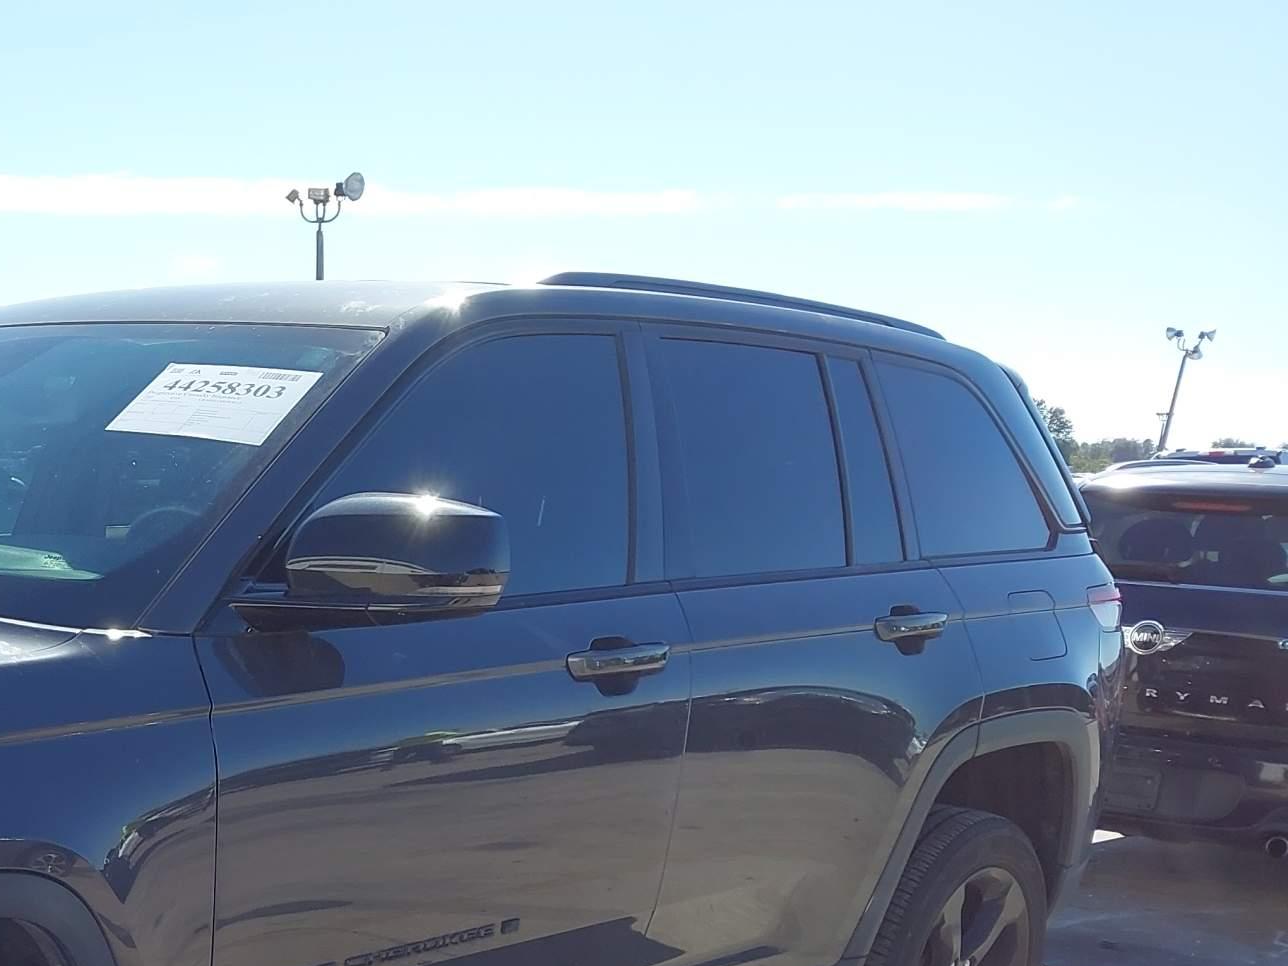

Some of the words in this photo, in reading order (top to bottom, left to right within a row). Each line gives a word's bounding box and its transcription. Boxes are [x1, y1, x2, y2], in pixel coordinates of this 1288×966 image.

[163, 379, 287, 398] 44258303
[1132, 631, 1160, 642] MINI
[1145, 688, 1288, 711] RYMA
